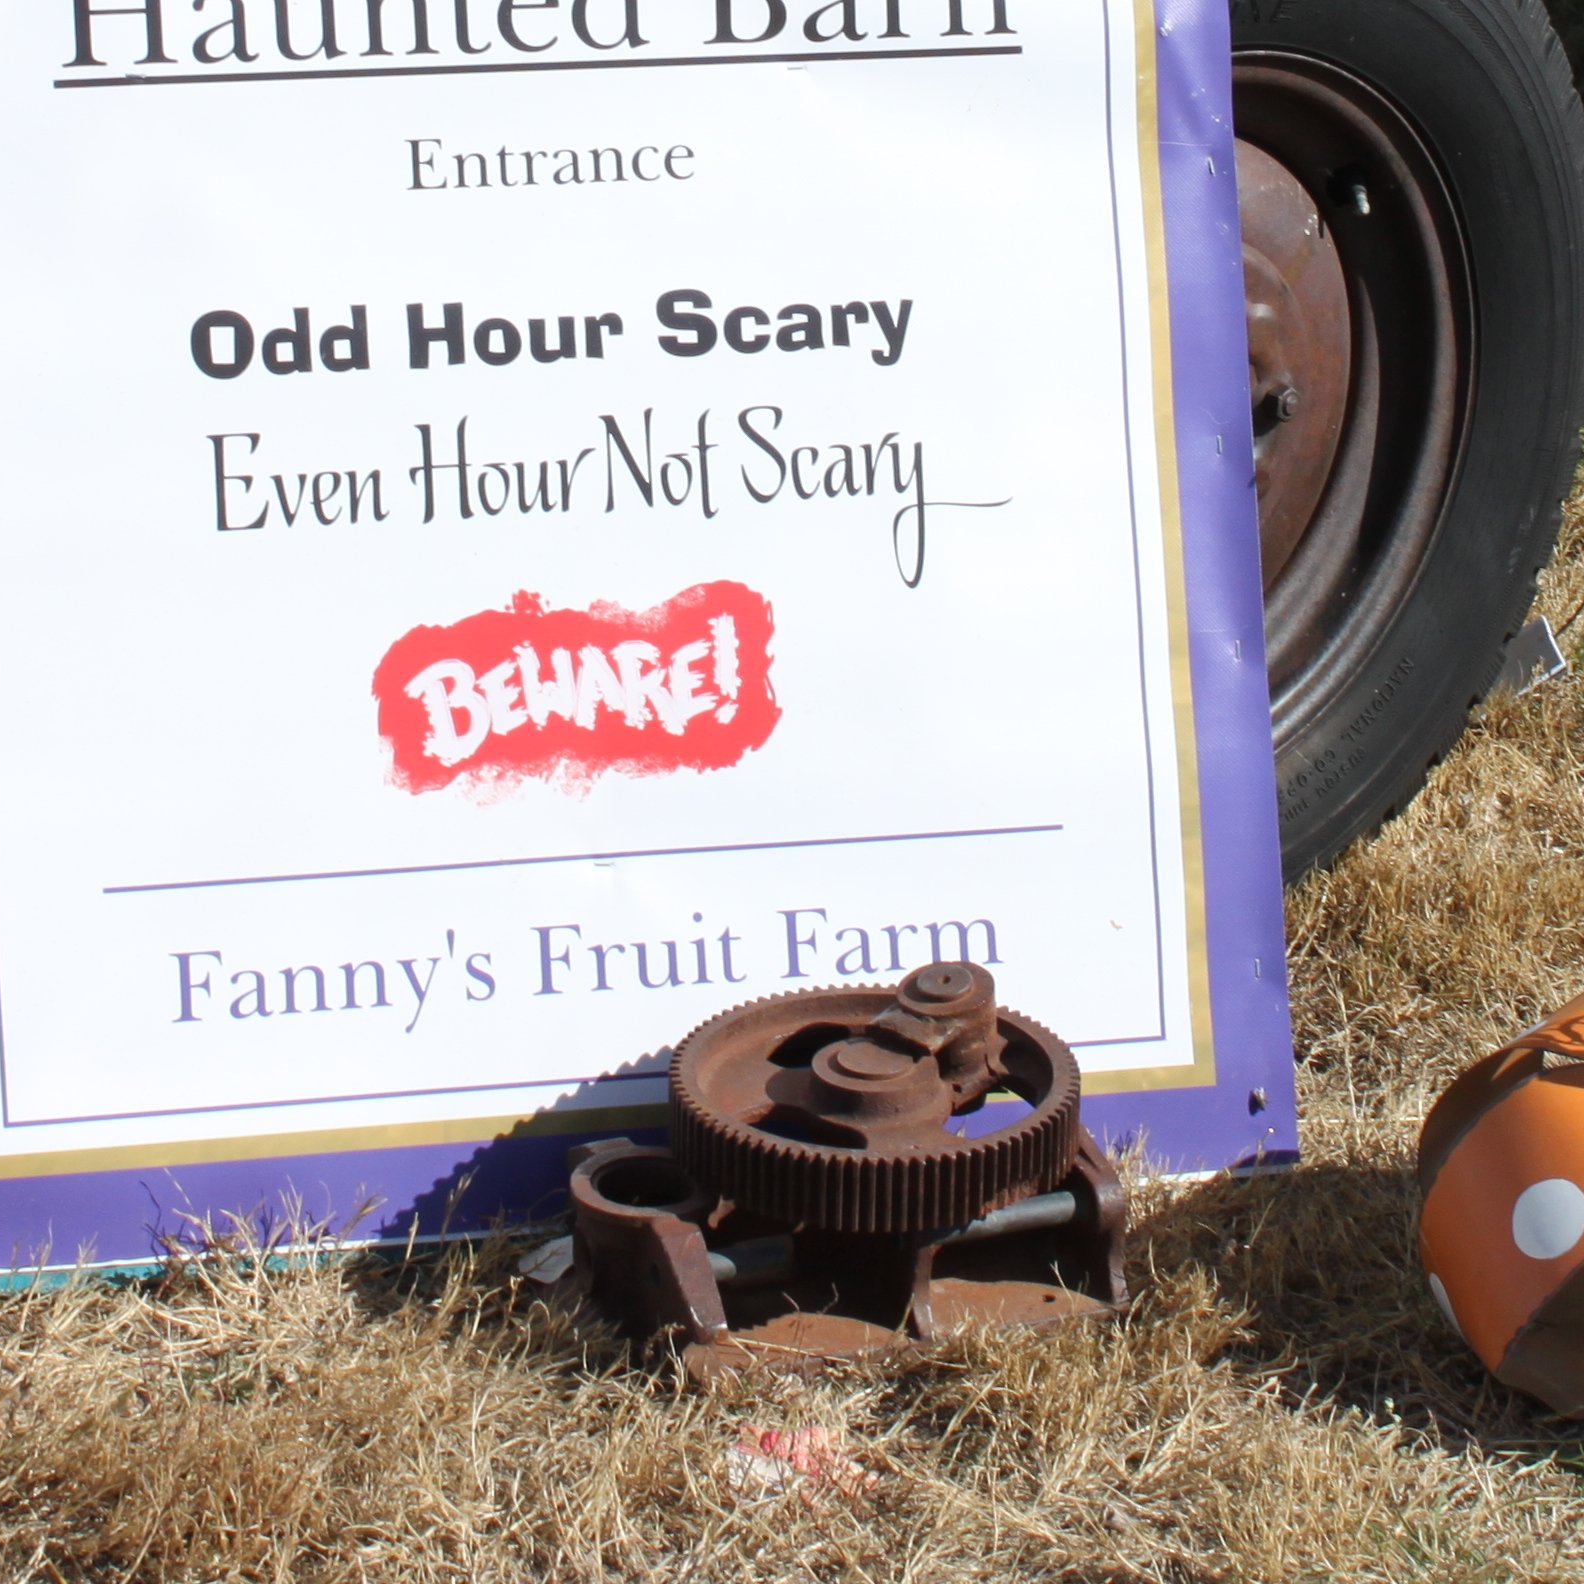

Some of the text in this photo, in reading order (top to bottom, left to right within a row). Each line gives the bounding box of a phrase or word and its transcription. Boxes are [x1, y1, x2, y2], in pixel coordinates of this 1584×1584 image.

[404, 138, 696, 191] Entrance
[189, 288, 914, 381] Odd Hour Scary
[205, 404, 1013, 590] Even Hour Not Scary
[404, 612, 743, 767] BEWARE!
[170, 907, 1004, 1033] Fanny's Fruit Farm
